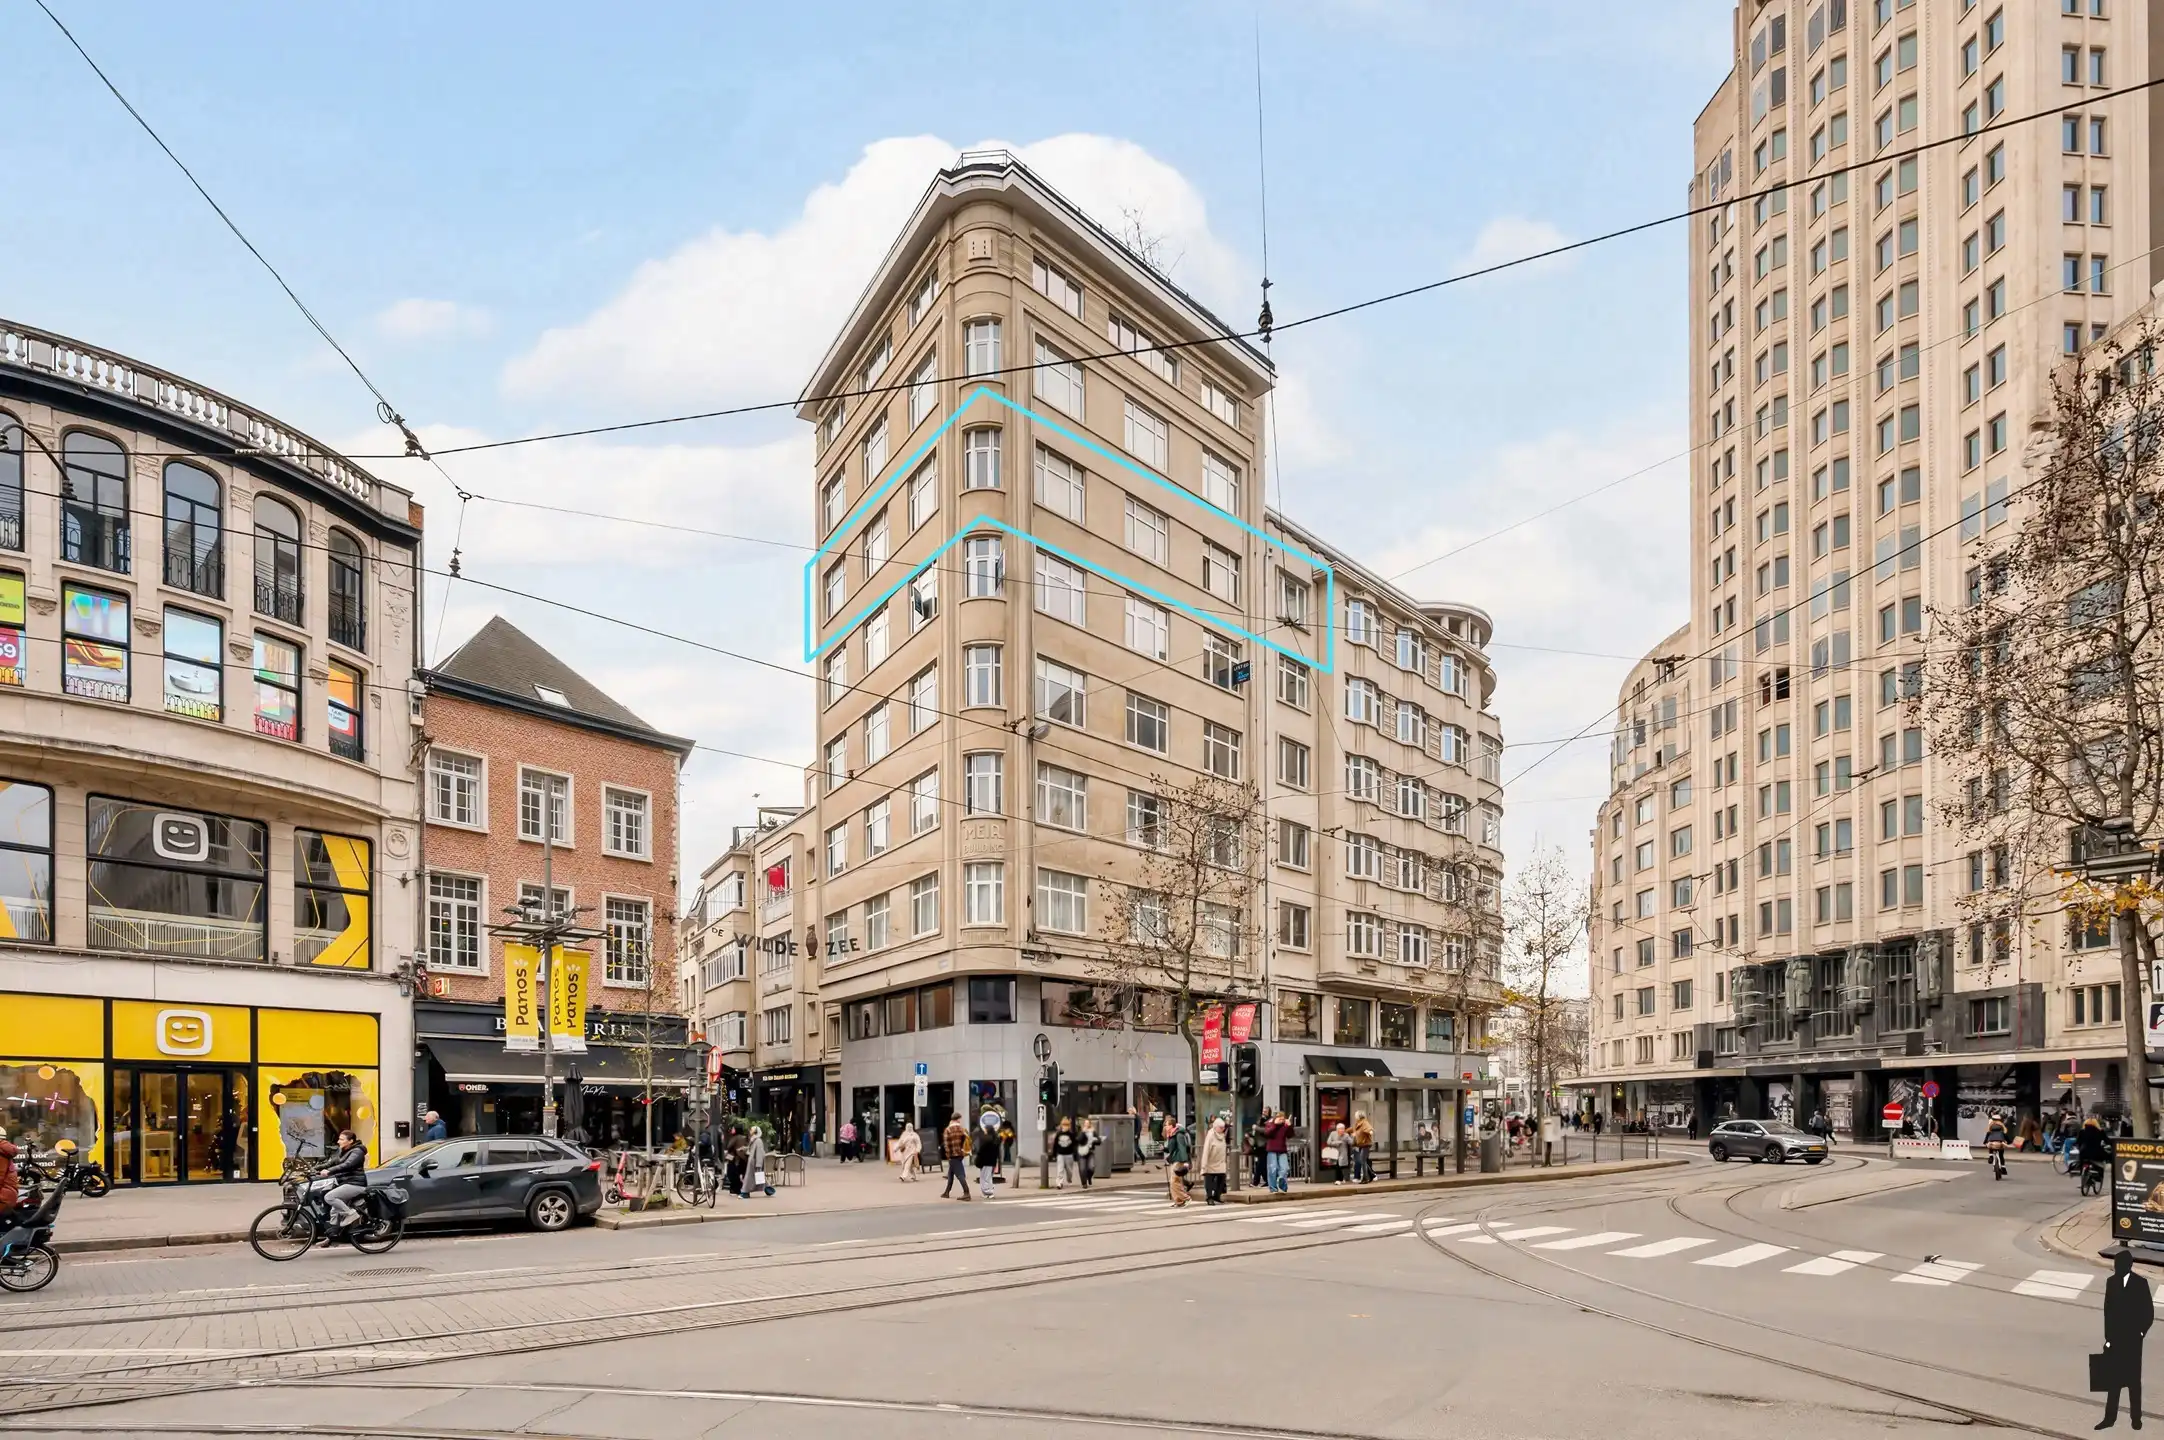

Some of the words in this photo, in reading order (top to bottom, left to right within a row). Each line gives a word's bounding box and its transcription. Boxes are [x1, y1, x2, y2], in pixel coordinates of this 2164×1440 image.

[0, 643, 16, 658] 9
[964, 823, 1005, 840] MEIR
[711, 927, 725, 938] DE
[733, 932, 798, 956] WILDE
[825, 938, 861, 956] ZEE
[515, 968, 529, 1026] Panos
[553, 968, 562, 1026] Panos
[2116, 1143, 2154, 1153] INKOOP
